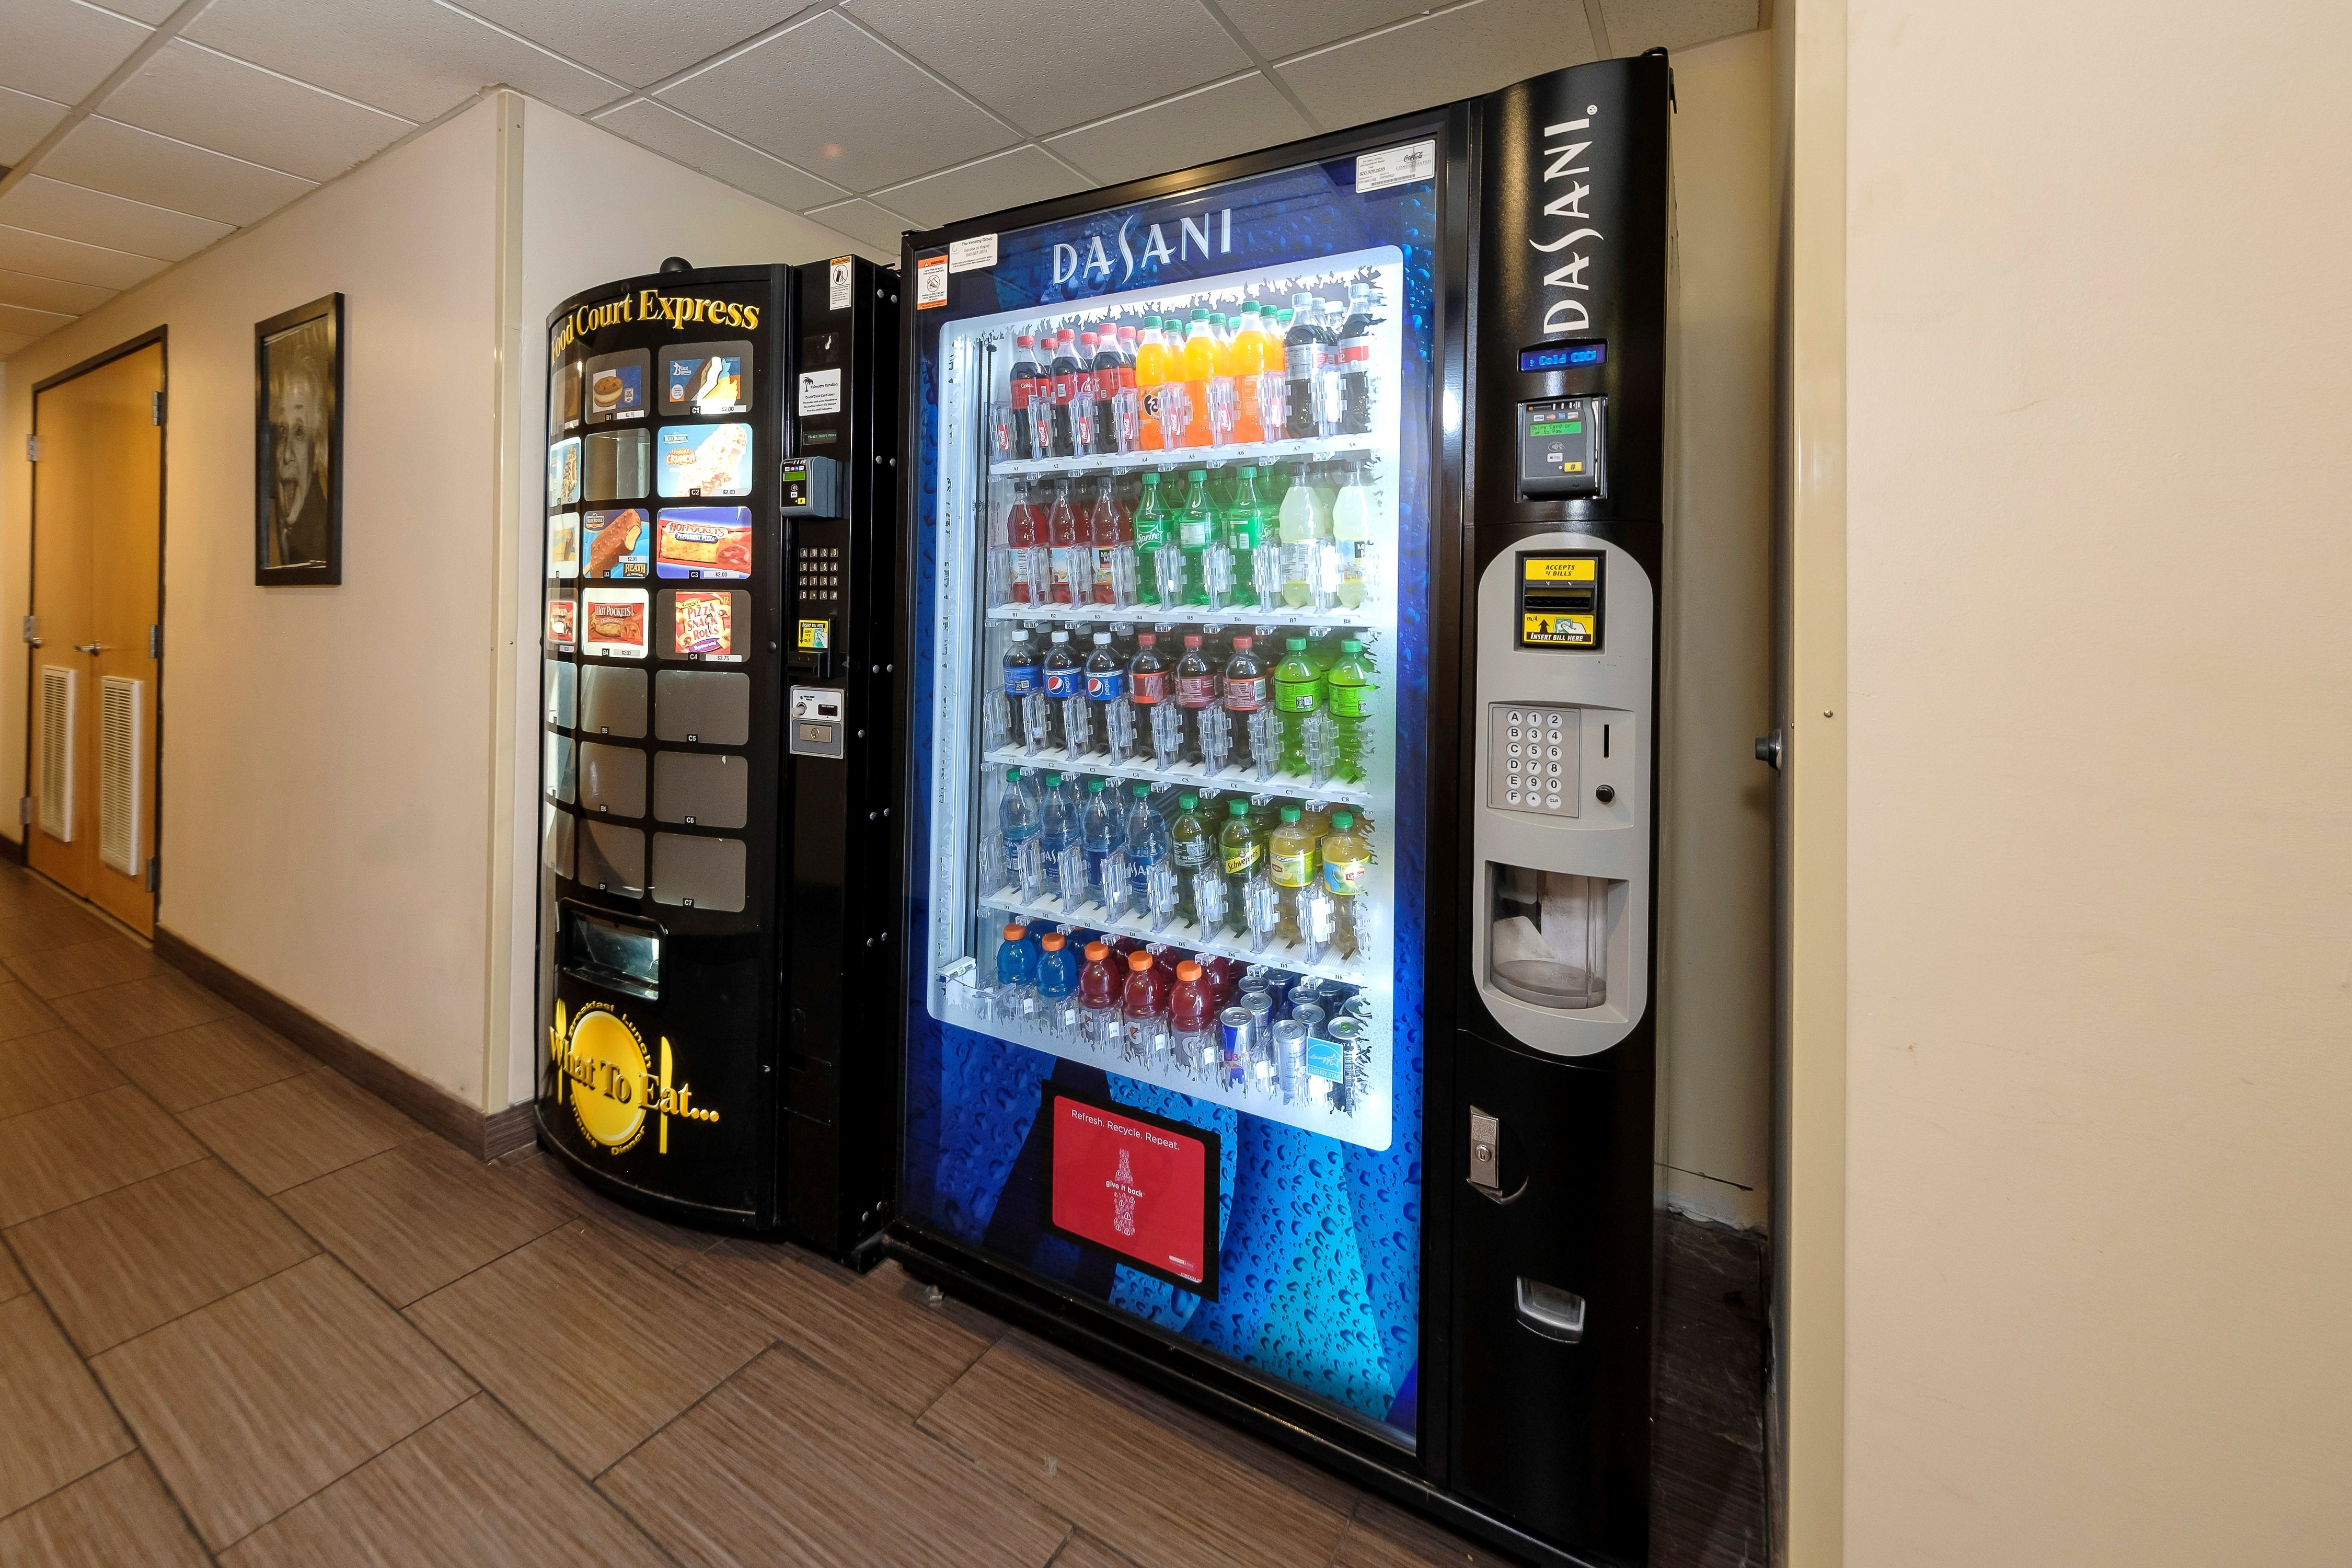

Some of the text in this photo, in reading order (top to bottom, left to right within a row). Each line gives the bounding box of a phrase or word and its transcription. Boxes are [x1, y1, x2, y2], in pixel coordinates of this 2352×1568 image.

[1396, 159, 1431, 170] CONSODATED
[1529, 118, 1604, 334] DASANI
[1053, 209, 1231, 284] DASANI
[577, 293, 633, 336] Court
[637, 289, 760, 330] Express
[1138, 531, 1160, 544] Sprite
[625, 563, 646, 574] HEATH
[596, 606, 631, 617] HOT POCKETS
[687, 603, 715, 619] PIZZA
[687, 615, 718, 631] SNACK
[693, 626, 719, 640] ROLLS
[1511, 713, 1519, 721] A
[1511, 729, 1518, 737] B
[1551, 748, 1558, 756] 6
[622, 1013, 651, 1068] Lunch
[550, 1025, 596, 1091] What
[601, 1059, 632, 1103] To
[1309, 1067, 1341, 1081] ENERGY STAR
[1071, 1109, 1180, 1150] Refresh. Recycle. Repeat.
[611, 1126, 645, 1156] Dinner
[1106, 1179, 1143, 1197] give it back
